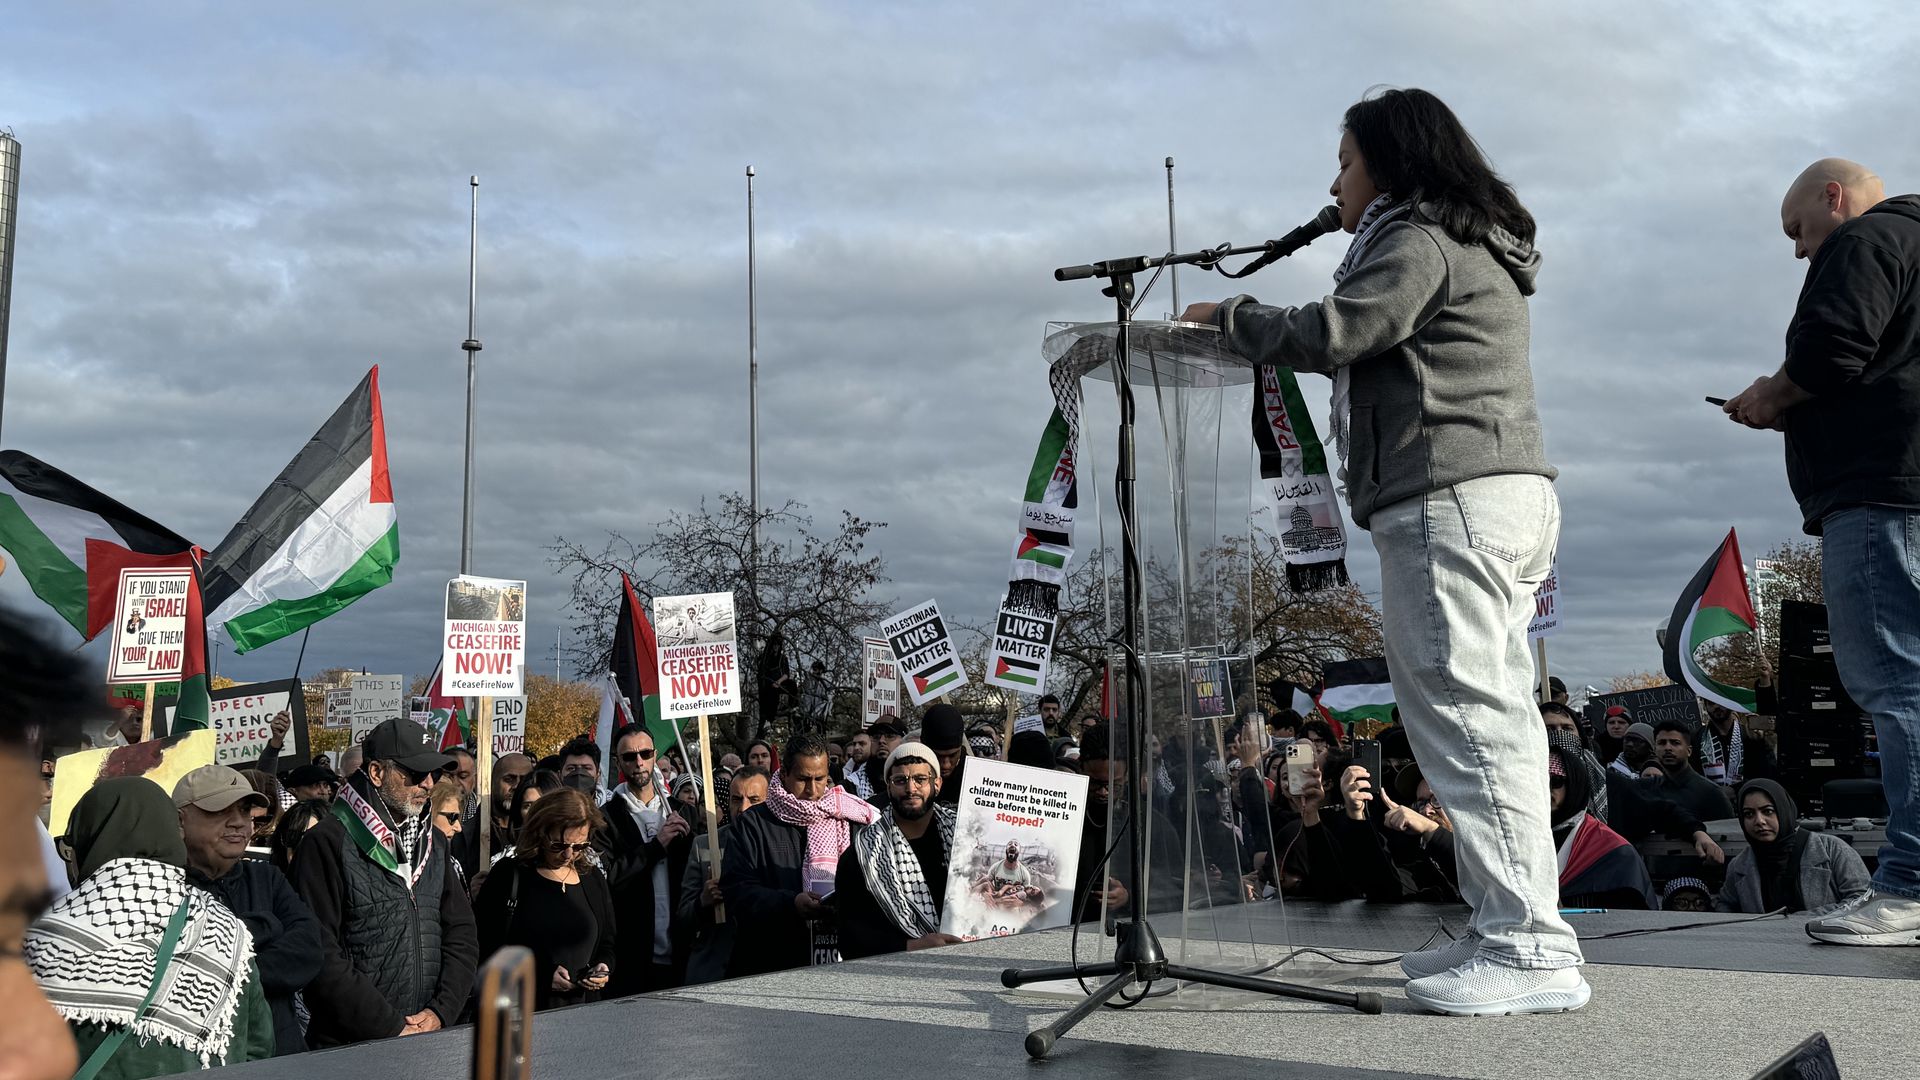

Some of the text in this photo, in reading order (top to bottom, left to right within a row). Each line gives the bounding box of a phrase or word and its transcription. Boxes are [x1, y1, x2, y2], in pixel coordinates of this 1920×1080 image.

[1274, 484, 1286, 501] لنا
[129, 580, 186, 594] IF YOU STAND
[132, 598, 186, 618] WITH ISRAEL
[1536, 594, 1554, 618] W!
[451, 622, 519, 634] MICHIGAN SAYS
[884, 605, 938, 636] PALESTINIAN
[1004, 616, 1045, 640] LIVES
[1526, 620, 1557, 634] seFireNow
[138, 630, 184, 645] GIVE THEM
[447, 634, 521, 650] CEASEFIRE
[896, 623, 939, 654] LIVES
[663, 644, 730, 660] MICHIGAN SAYS
[900, 640, 952, 673] MATTER
[996, 638, 1046, 660] MATTER
[122, 646, 181, 671] YOUR LAND
[456, 652, 512, 675] NOW!
[661, 654, 735, 677] CEASEFIRE
[876, 662, 896, 680] ISRAEL
[354, 680, 402, 690] THIS IS
[452, 680, 514, 690] #CeaseFireNow
[671, 672, 728, 700] NOW!
[212, 696, 265, 713] SPECT
[354, 698, 374, 711] NOT
[495, 699, 523, 716] END
[670, 698, 732, 712] #CeaseFireNow
[214, 713, 274, 730] STENC
[1636, 704, 1696, 724] FUNDING
[492, 717, 518, 733] THE
[216, 728, 268, 745] EXPEC
[493, 735, 524, 753] ENOCIDE
[982, 776, 1067, 799] How many innocent
[969, 786, 1077, 812] children must be killed in
[340, 786, 395, 848] ALESTINE
[974, 797, 1069, 821] Gaza before the war is
[996, 812, 1045, 828] stopped?
